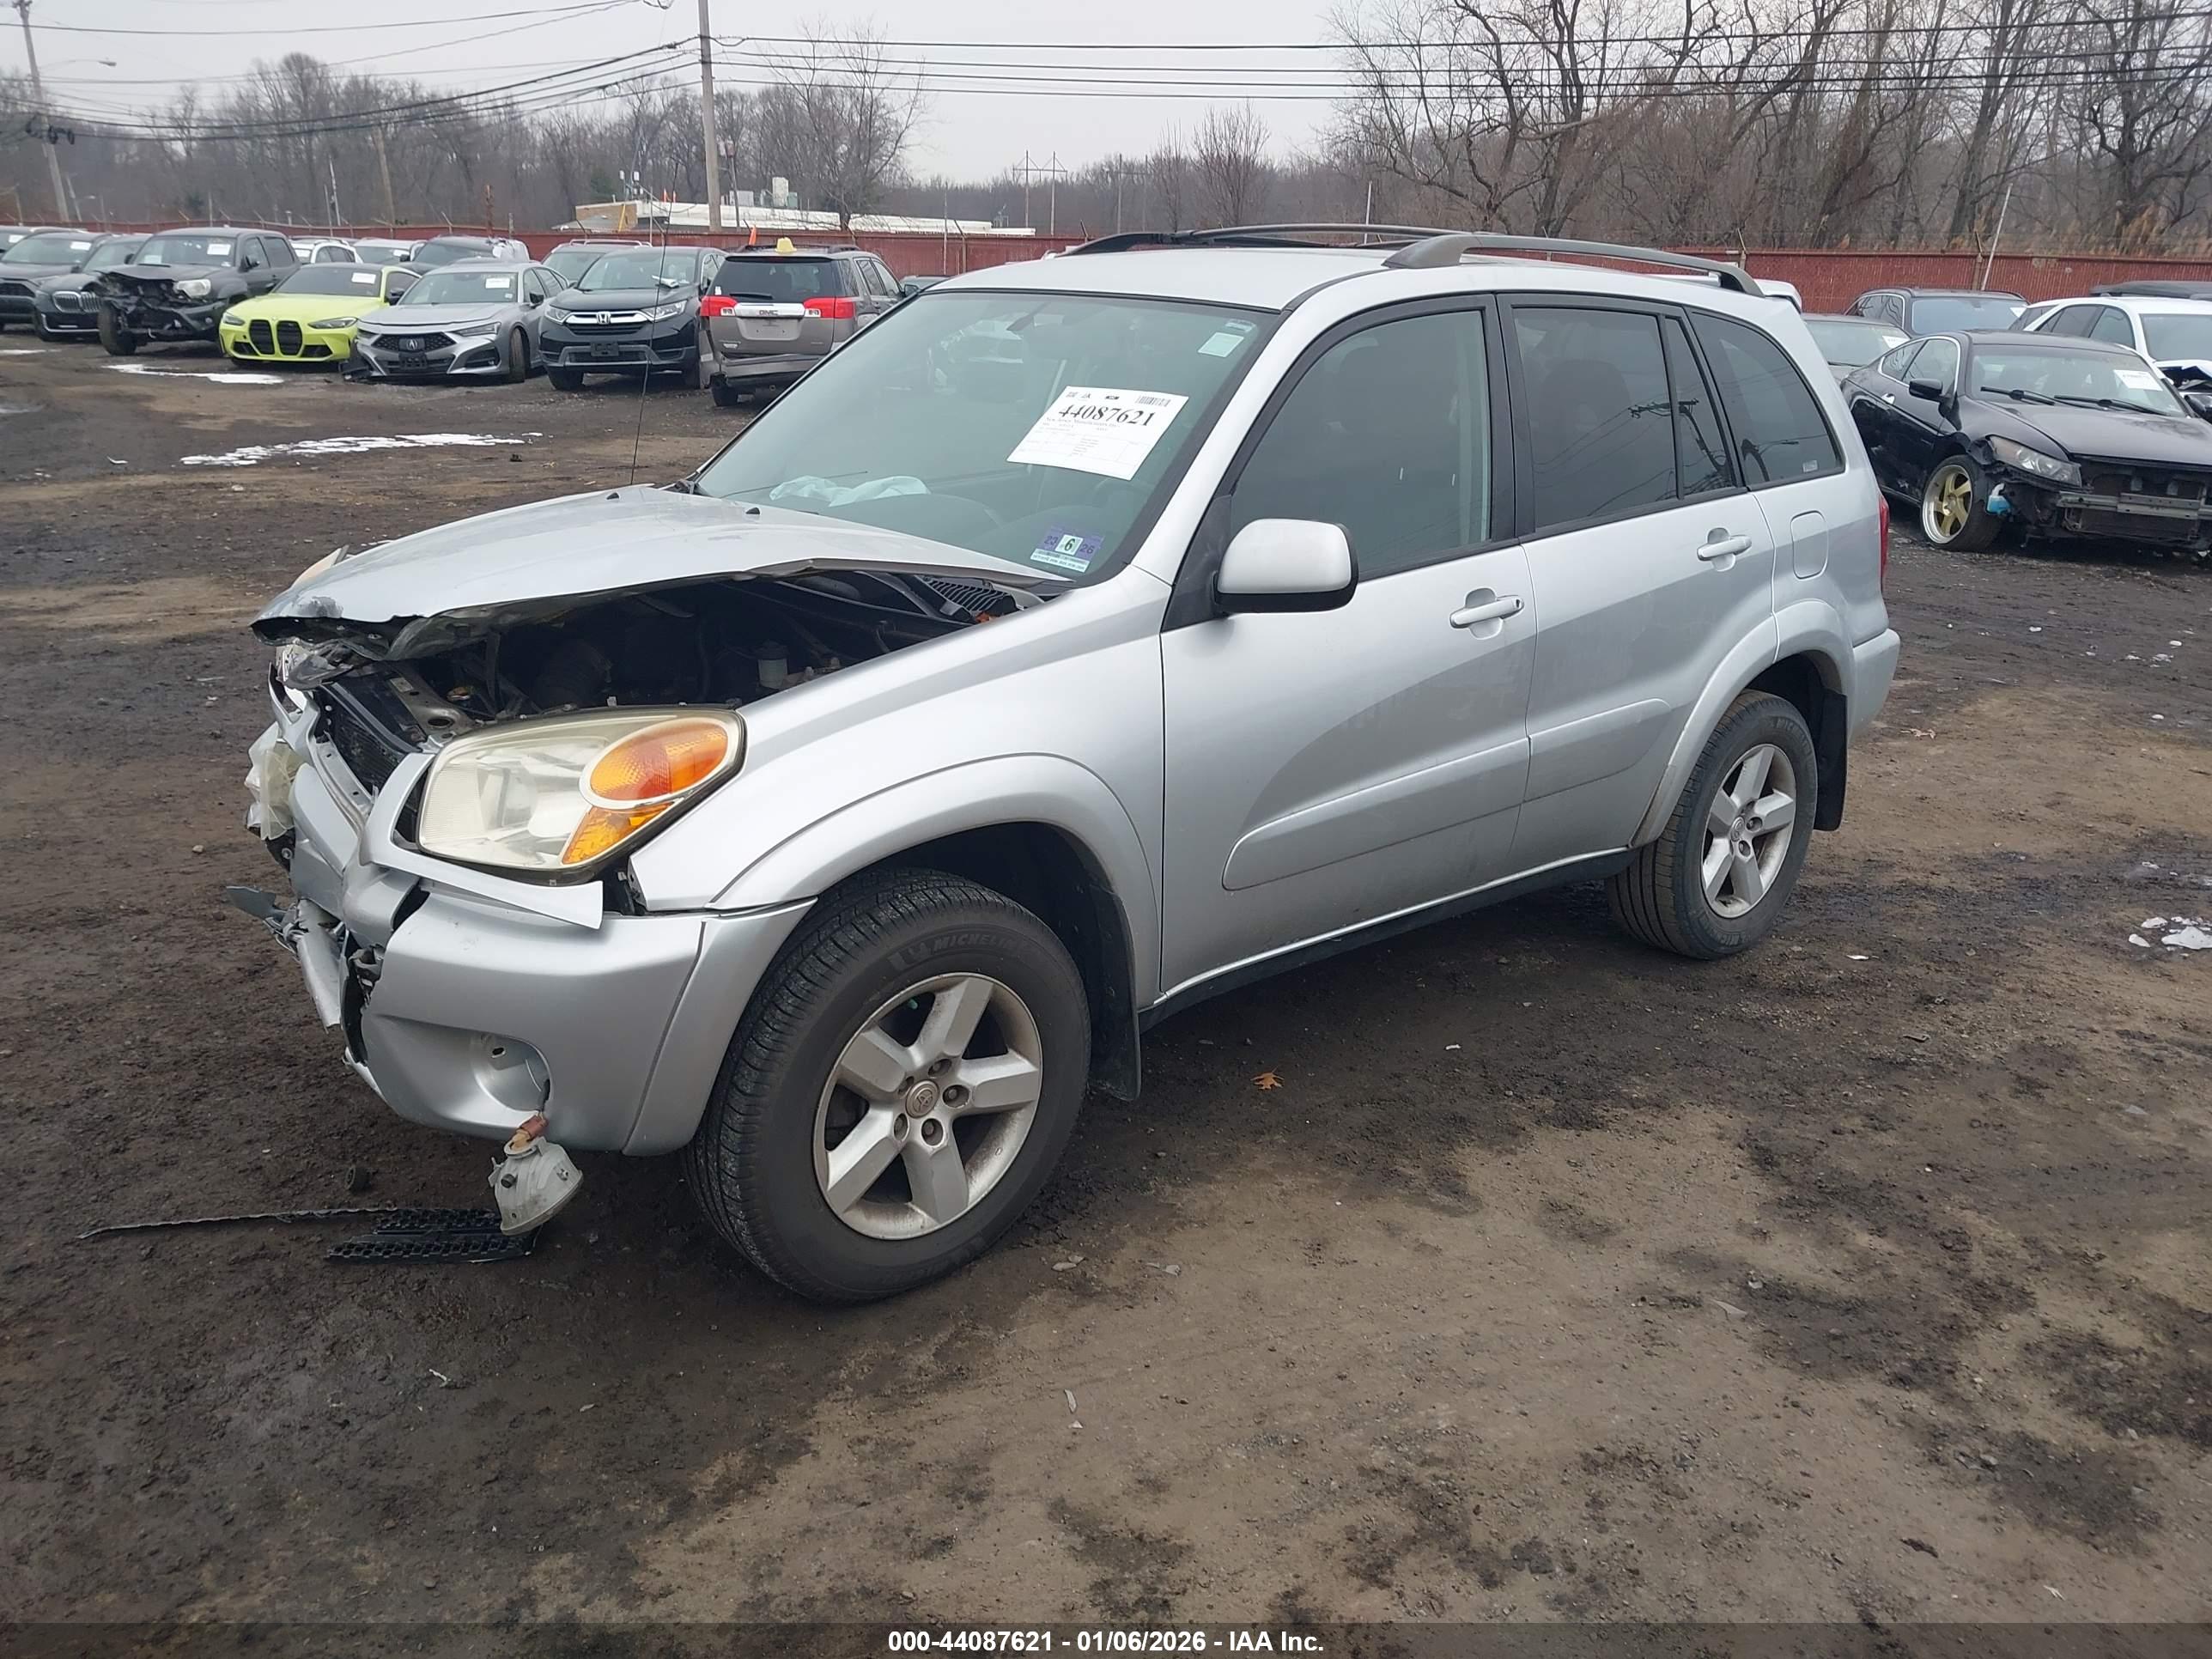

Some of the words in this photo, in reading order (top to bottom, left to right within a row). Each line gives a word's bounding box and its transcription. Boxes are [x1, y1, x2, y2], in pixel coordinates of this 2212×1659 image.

[1059, 404, 1156, 427] 44087621
[1064, 539, 1076, 551] 6
[1079, 544, 1094, 554] 26
